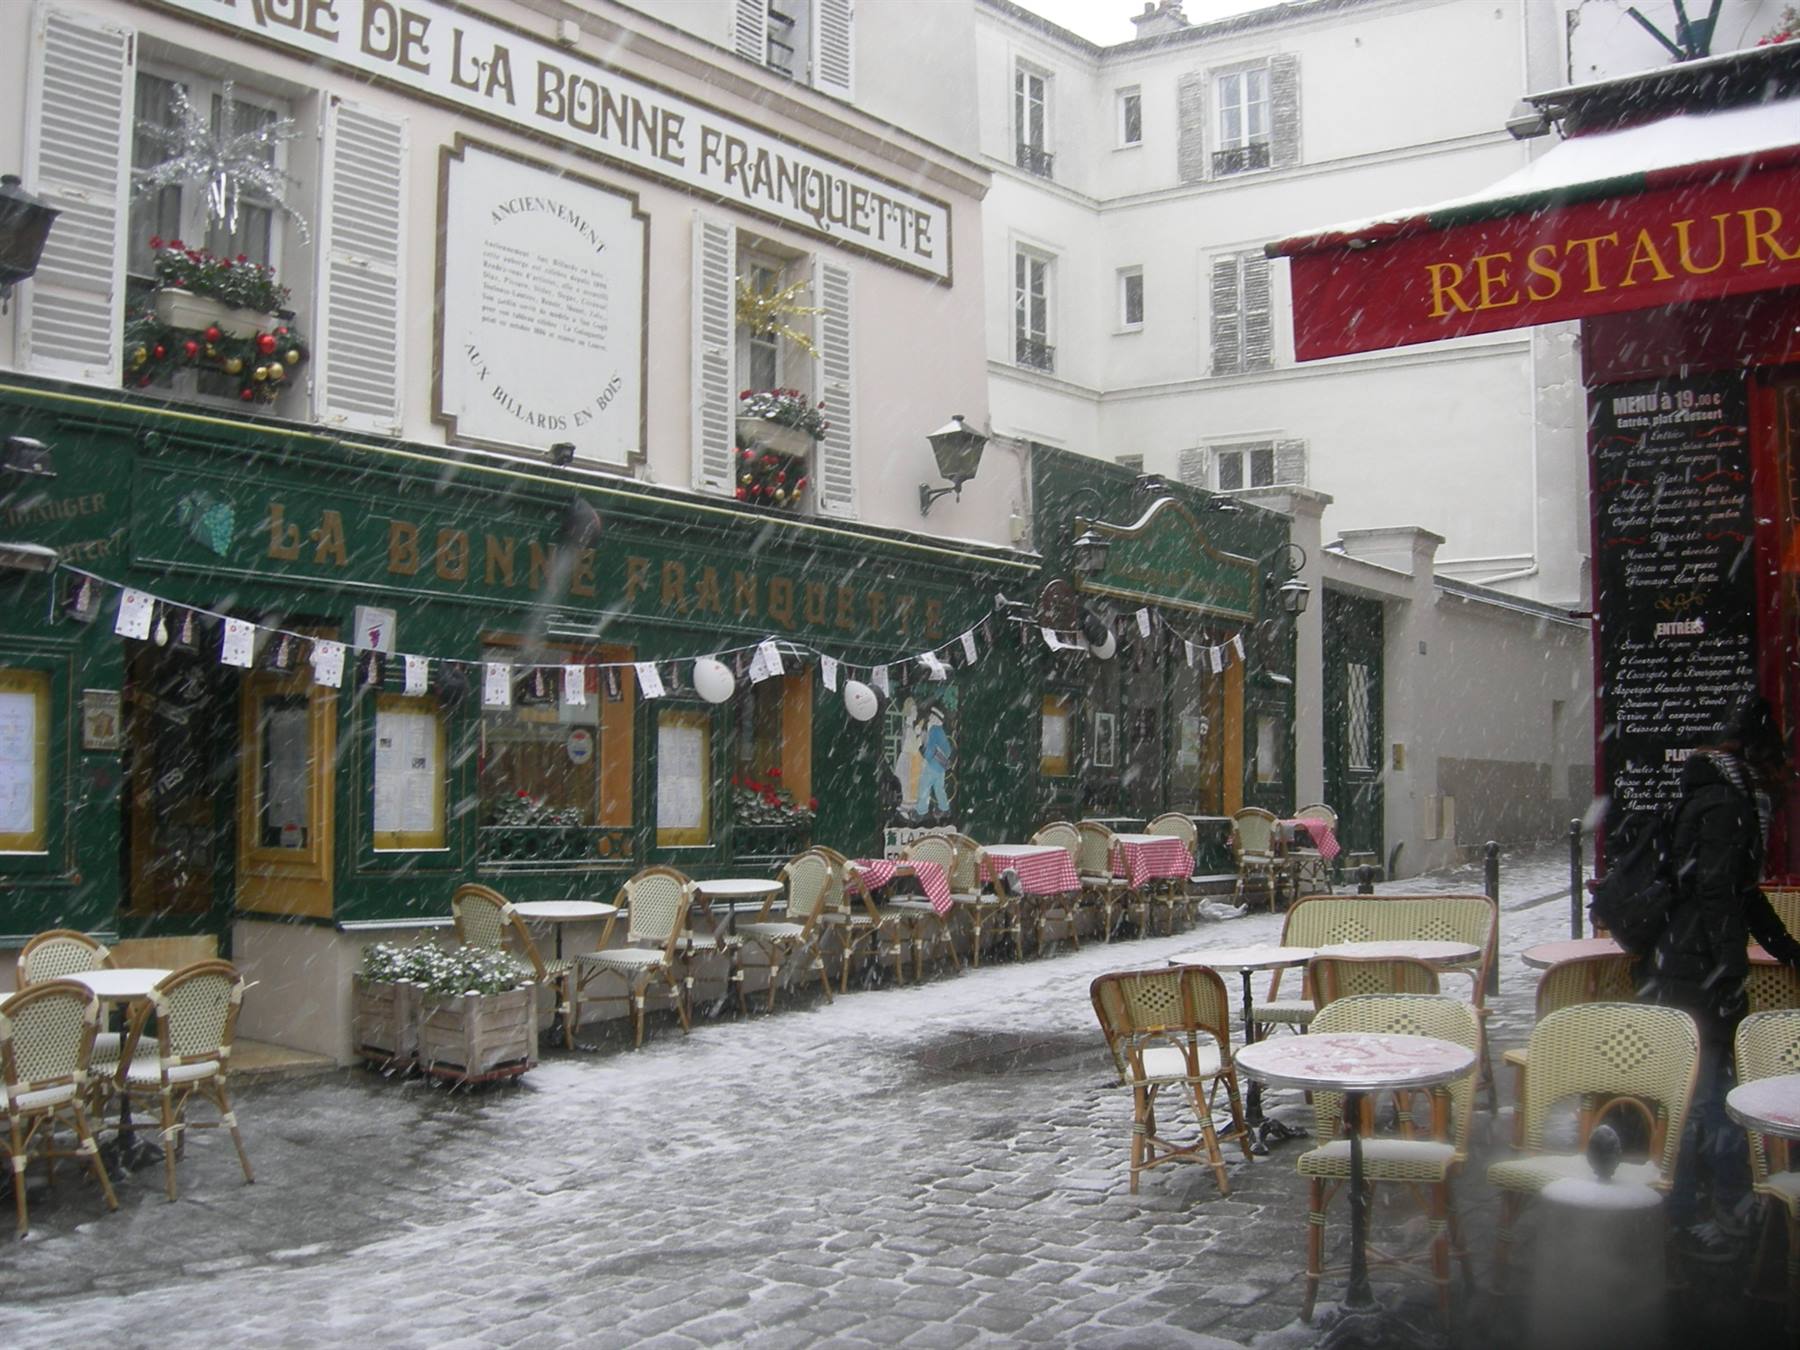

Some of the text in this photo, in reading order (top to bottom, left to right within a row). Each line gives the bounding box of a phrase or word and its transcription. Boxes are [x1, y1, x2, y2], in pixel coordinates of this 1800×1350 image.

[360, 0, 431, 75] DE
[450, 29, 516, 106] LA
[536, 61, 686, 167] BONNE
[700, 125, 933, 259] FRANQUETTE
[490, 196, 608, 254] ANCIENNEMENT
[1426, 206, 1800, 318] RESTAUR
[464, 342, 624, 431] AUX BILLARDS EN BOIS
[1613, 394, 1658, 415] MENU
[1661, 391, 1672, 410] à
[268, 503, 945, 640] LA BONNE FRANQUETTE
[1656, 617, 1705, 635] ENTRÉES
[1665, 748, 1698, 762] PLAT
